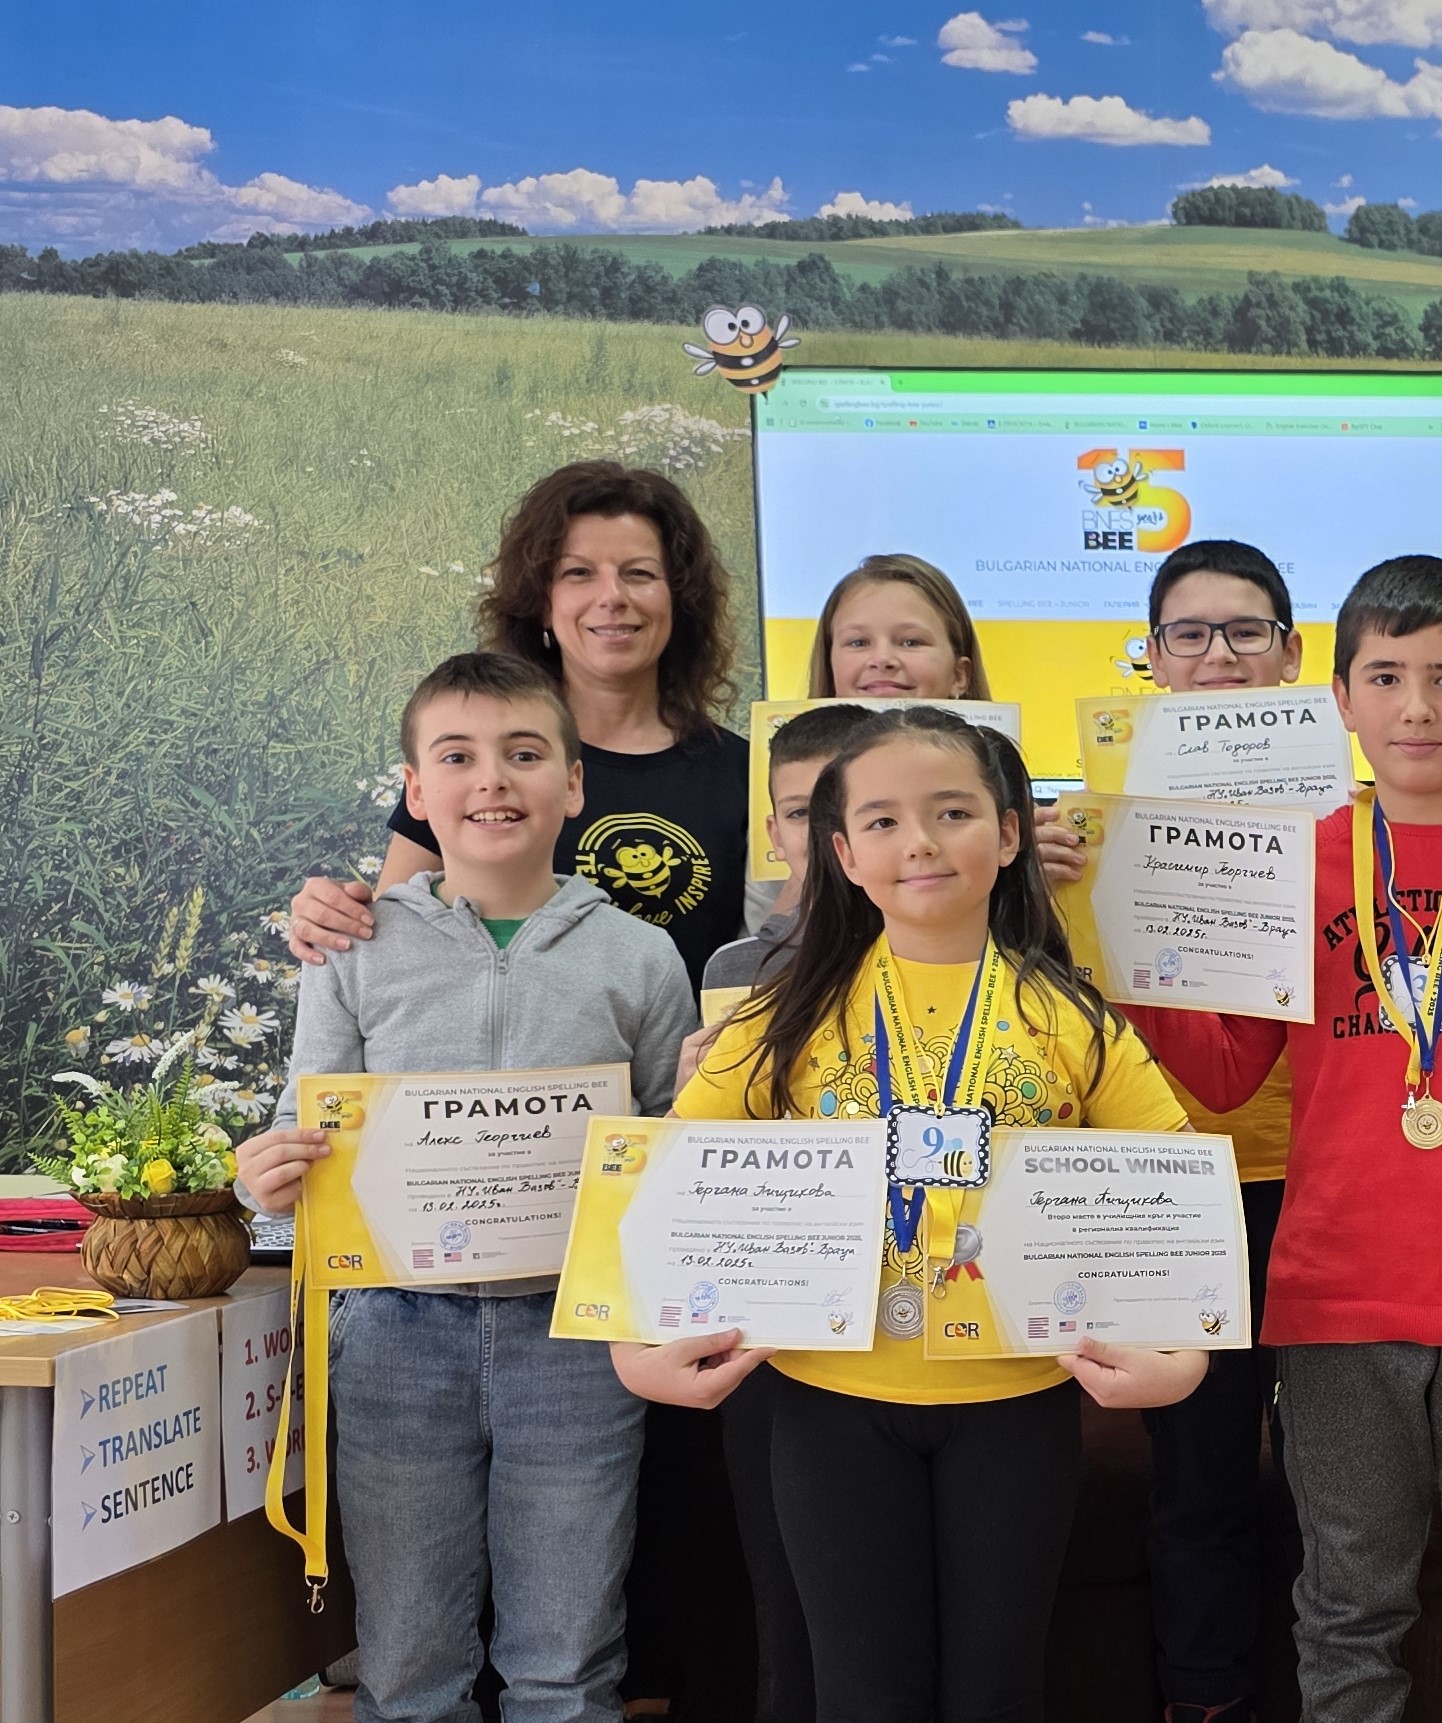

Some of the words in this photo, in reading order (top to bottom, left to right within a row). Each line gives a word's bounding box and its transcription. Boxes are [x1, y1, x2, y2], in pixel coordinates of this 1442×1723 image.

[1082, 510, 1134, 531] BNES
[1084, 531, 1133, 550] BEE
[975, 559, 1057, 572] BULGARIAN
[1061, 560, 1131, 573] NATIONAL
[1277, 562, 1296, 574] EE
[1179, 708, 1316, 731] ГРАМОТА
[1177, 741, 1208, 755] Слав
[1218, 737, 1270, 757] Тодоров
[1135, 812, 1176, 821] BULGARIAN
[1178, 816, 1213, 825] NATIONAL
[1215, 819, 1245, 827] ENGLISH
[1247, 822, 1280, 831] SPELLING
[1150, 825, 1282, 854] ГРАМОТА
[1143, 854, 1208, 880] Красимир
[1214, 861, 1275, 885] Георгиев
[675, 857, 711, 914] INSPIRE
[1178, 945, 1253, 959] CONGRATULATIONS!
[882, 971, 897, 1017] BULGARIAN
[893, 1015, 906, 1055] NATIONAL
[903, 1053, 916, 1093] ENGLISH
[965, 1069, 979, 1106] NATIONAL
[975, 1029, 987, 1067] ENGLISH
[981, 988, 993, 1026] SPELLING
[989, 973, 997, 988] BEE
[404, 1087, 456, 1097] BULGARIAN
[459, 1086, 504, 1095] NATIONAL
[507, 1084, 544, 1092] ENGLISH
[547, 1081, 588, 1090] SPELLING
[423, 1093, 592, 1120] ГРАМОТА
[417, 1129, 462, 1145] Алекс
[475, 1124, 552, 1148] Георгиев
[922, 1126, 945, 1158] 9
[701, 1149, 853, 1169] ГРАМОТА
[1024, 1156, 1119, 1174] SCHOOL
[1125, 1158, 1215, 1174] WINNER
[688, 1180, 748, 1203] Гергана
[1030, 1190, 1087, 1212] Гергана
[465, 1212, 561, 1226] CONGRATULATIONS!
[718, 1278, 808, 1286] CONGRATULATIONS!
[1078, 1269, 1169, 1278] CONGRATULATIONS!
[245, 1338, 258, 1366] 1.
[99, 1364, 168, 1413] REPEAT
[246, 1391, 260, 1420] 2.
[99, 1407, 202, 1468] TRANSLATE
[246, 1446, 260, 1474] 3.
[101, 1462, 194, 1523] SENTENCE
